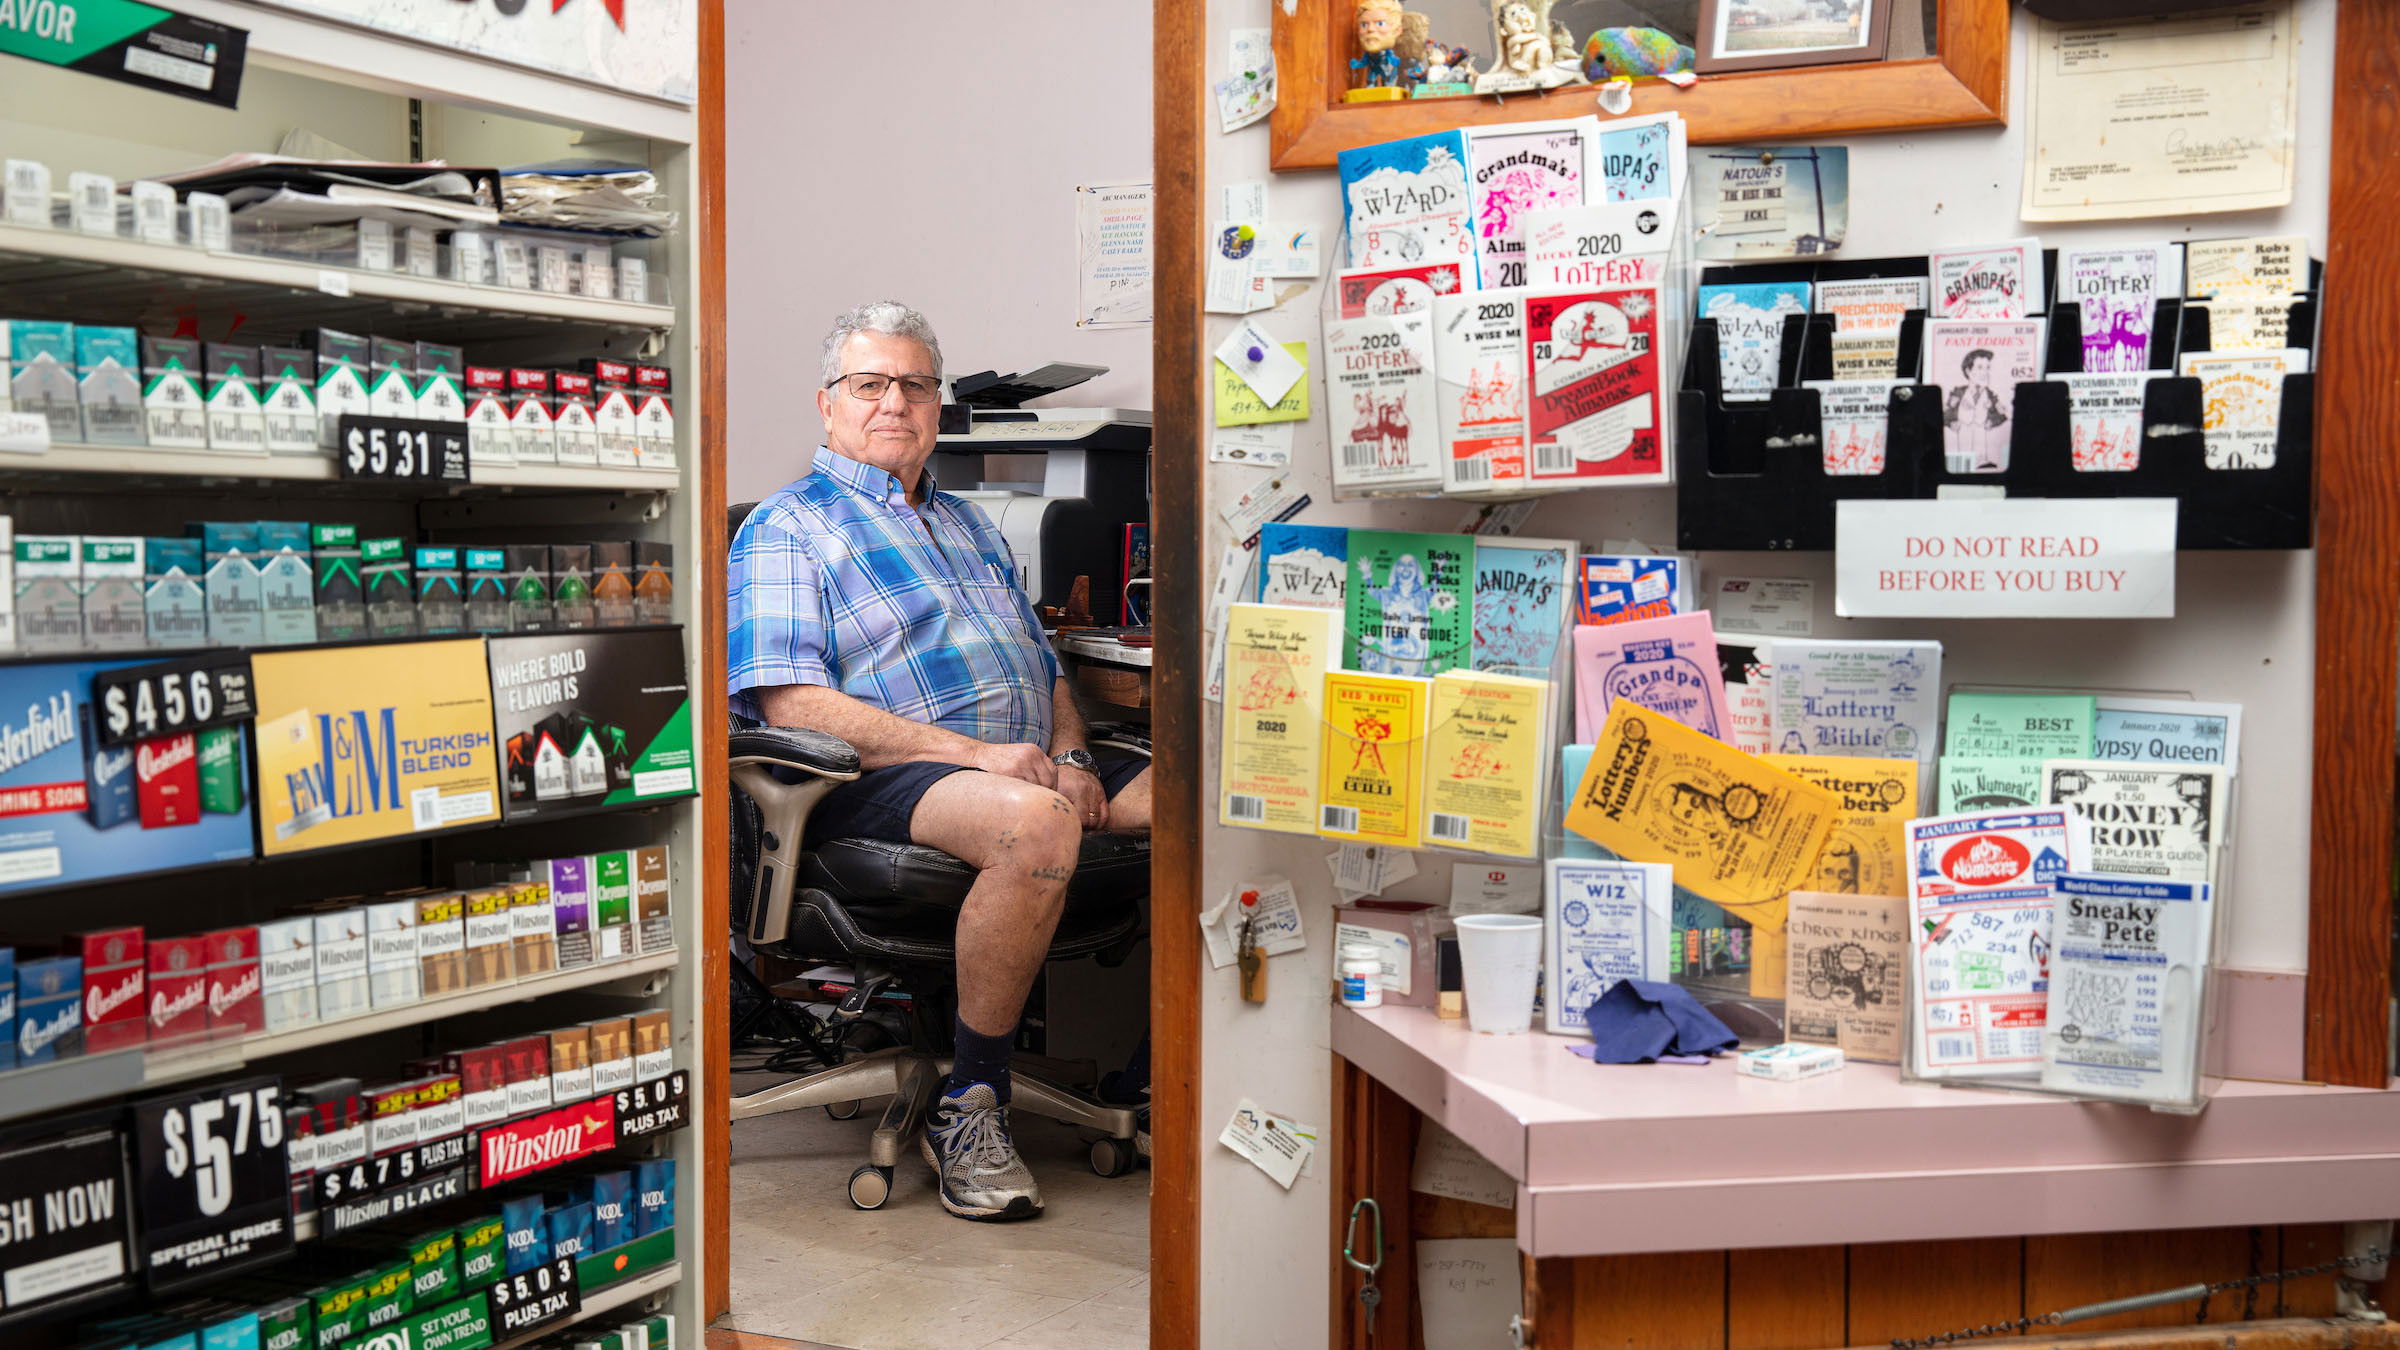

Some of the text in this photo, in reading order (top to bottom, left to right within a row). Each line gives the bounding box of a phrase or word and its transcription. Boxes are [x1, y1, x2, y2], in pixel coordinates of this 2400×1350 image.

[1476, 151, 1569, 184] Grandma's
[1723, 165, 1783, 181] NATOUR'S
[1113, 193, 1146, 201] MANAGERS
[1365, 185, 1447, 217] WIZARD
[1725, 189, 1738, 202] THE
[1103, 214, 1143, 223] SHEILA PAGE
[1448, 217, 1459, 236] 5
[1126, 238, 1144, 246] NASH
[1367, 231, 1380, 250] 8
[1457, 234, 1469, 254] 6
[1577, 233, 1622, 257] 2020
[2254, 243, 2290, 254] Rob's
[2261, 255, 2290, 265] Best
[2254, 266, 2290, 277] Picks
[1945, 271, 2017, 303] GRANDPA'S
[2077, 274, 2153, 295] LOTTERY
[1478, 302, 1514, 321] 2020
[1832, 302, 1907, 317] PREDICTIONS
[1841, 318, 1897, 330] ON THE DAY
[1361, 333, 1400, 350] 2020
[1475, 330, 1501, 341] WISE
[1631, 335, 1648, 351] 20
[1833, 339, 1896, 352] JANUARY 2020
[1944, 336, 2025, 347] FAST EDDIE'S
[1346, 348, 1410, 370] LOTTERY
[1535, 344, 1552, 360] 20
[1836, 359, 1865, 369] WISE
[1340, 373, 1369, 382] THREE
[2071, 378, 2138, 389] DECEMBER 2019
[2202, 372, 2271, 392] Grandma's
[1828, 386, 1885, 396] JANUARY 2020
[1833, 404, 1861, 414] WISE
[2079, 397, 2141, 408] WISE MEN
[2236, 429, 2274, 440] Specials
[1428, 549, 1461, 562] Rob's
[1905, 535, 2099, 558] DO NOT READ
[1431, 563, 1460, 574] Best
[1427, 574, 1460, 586] Picks
[1878, 569, 2127, 592] BEFORE YOU BUY
[1364, 624, 1452, 642] LOTTERY GUIDE
[1633, 648, 1665, 661] 2020
[1808, 651, 1864, 660] Good For All
[496, 649, 587, 689] WHERE BOLD
[1616, 665, 1701, 697] Grandpa
[509, 676, 579, 713] FLAVOR IS
[1341, 690, 1401, 705] RED DEVIL
[1803, 696, 1896, 722] Lottery
[1972, 713, 1981, 725] 4
[1256, 720, 1287, 733] 2020
[2025, 718, 2074, 731] BEST
[2119, 719, 2181, 733] January 2020
[401, 732, 490, 757] TURKISH
[1813, 725, 1883, 747] Bible
[2095, 738, 2219, 762] ypsy Queen
[316, 706, 404, 818] L&M
[402, 751, 472, 775] BLEND
[1591, 738, 1634, 811] Lottery
[1605, 738, 1652, 824] Numbers
[2103, 772, 2159, 784] JANUARY
[45, 785, 86, 808] SOON
[1952, 779, 1973, 801] Mr.
[2114, 792, 2145, 802] $1.50
[2073, 802, 2189, 826] MONEY
[1917, 814, 2060, 839] JANUARY 2020
[2031, 827, 2065, 838] $1.50
[2091, 826, 2165, 848] ROW
[2106, 847, 2204, 861] PLAYER'S GUIDE
[1586, 884, 1626, 899] WIZ
[2064, 881, 2169, 897] World Class Lottery Guide
[513, 911, 550, 931] Winston
[2013, 910, 2040, 924] 690
[2069, 898, 2158, 925] Sneaky
[469, 919, 508, 940] Winston
[1972, 913, 2004, 933] 587
[2104, 922, 2156, 942] Pete
[421, 926, 462, 949] Winston
[1950, 927, 1974, 950] 712
[623, 1105, 680, 1136] PLUS TAX
[421, 1142, 443, 1168] PLUS
[444, 1136, 464, 1158] TAX
[486, 1122, 581, 1180] Winston
[45, 1178, 115, 1235] NOW
[334, 1178, 458, 1230] Winston BLACK
[150, 1218, 284, 1268] SPECIAL PRICE
[186, 1242, 251, 1269] PLUS TAX
[464, 1252, 496, 1278] KOOL
[414, 1266, 448, 1293] KOOL
[505, 1294, 570, 1329] PLUS TAX
[420, 1307, 472, 1338] SET YOUR
[423, 1317, 487, 1350] OWN TREND
